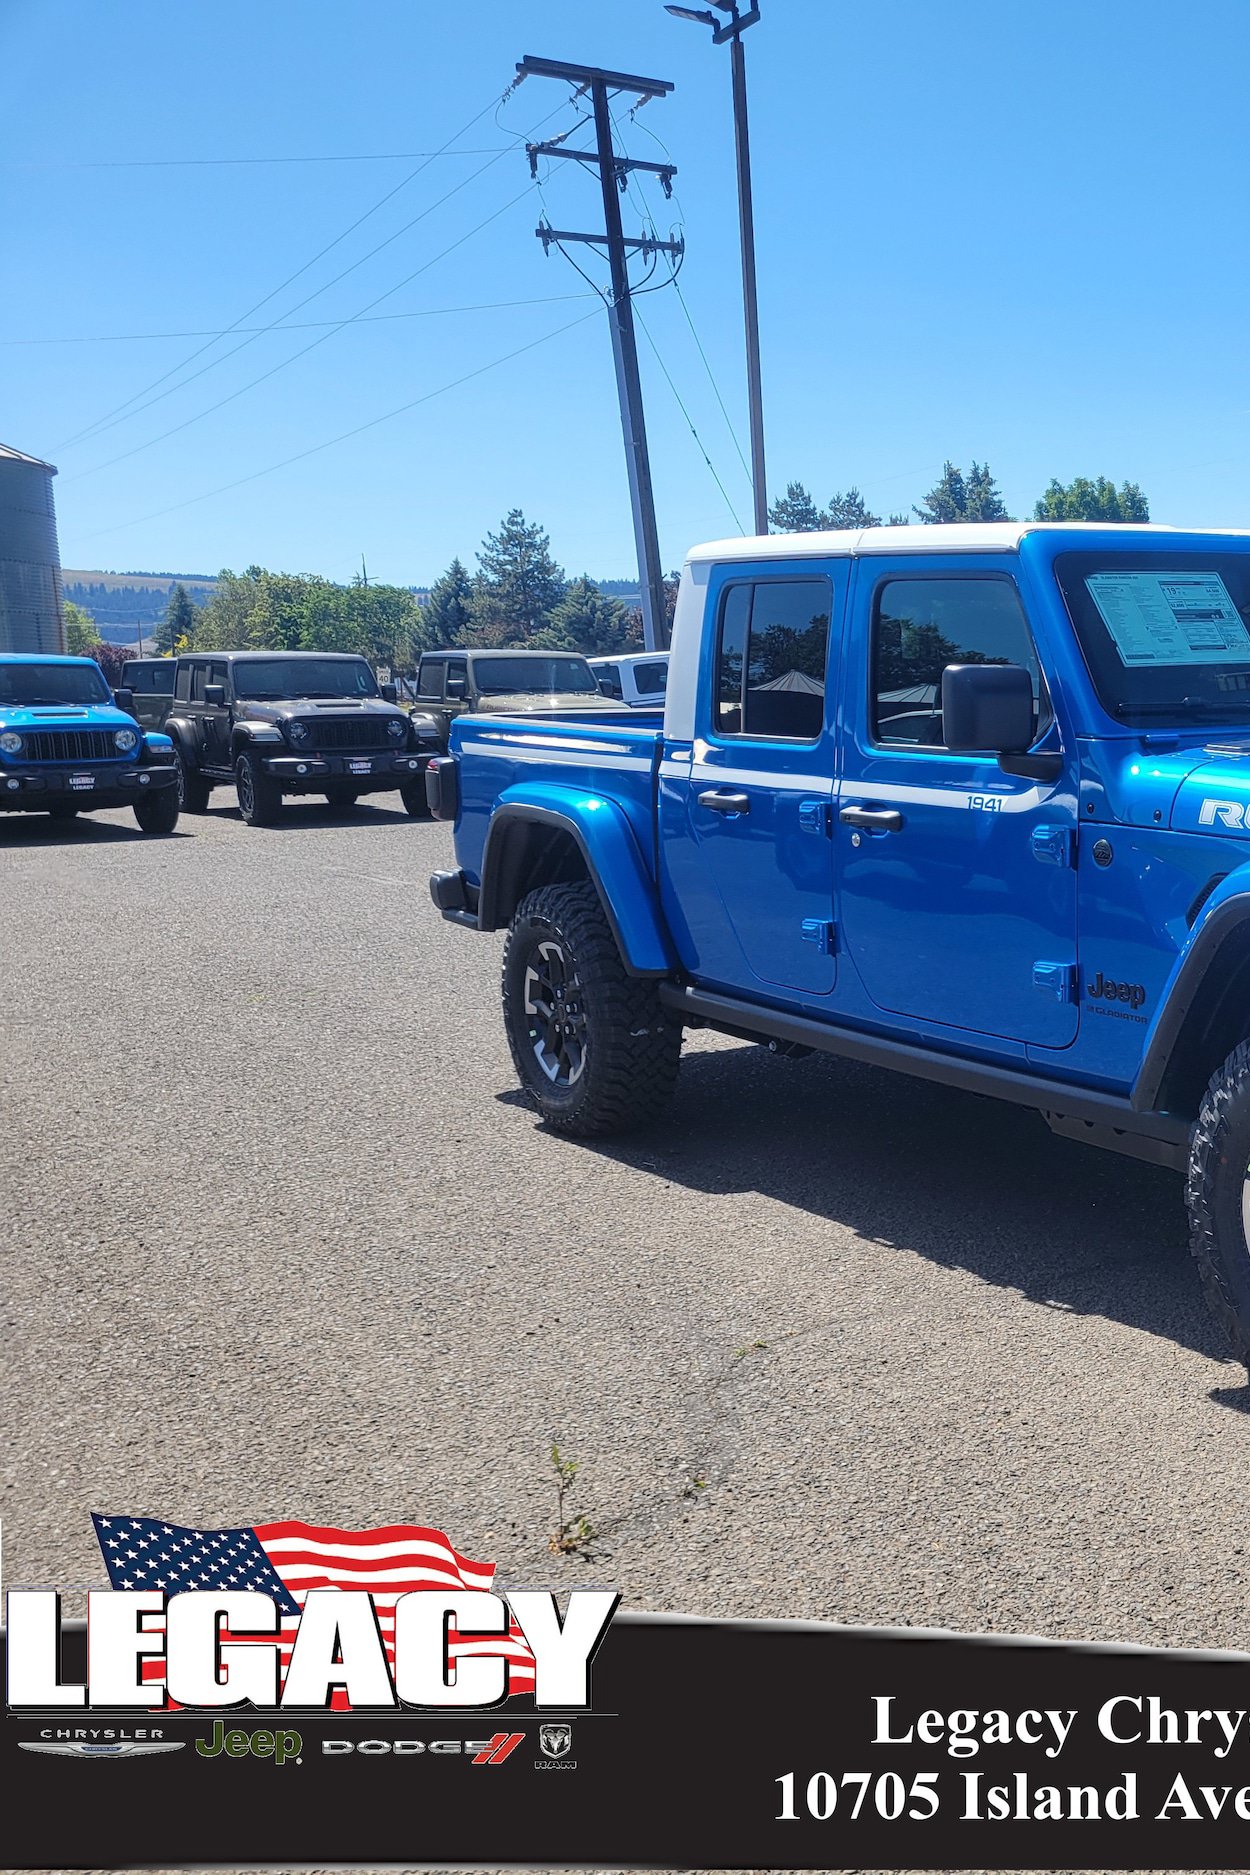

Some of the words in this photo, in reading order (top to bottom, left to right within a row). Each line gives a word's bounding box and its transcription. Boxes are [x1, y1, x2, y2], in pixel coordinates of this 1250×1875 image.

[967, 795, 1003, 812] 1941
[1087, 971, 1146, 1011] Jeep
[1096, 1006, 1149, 1025] GLADIATOR
